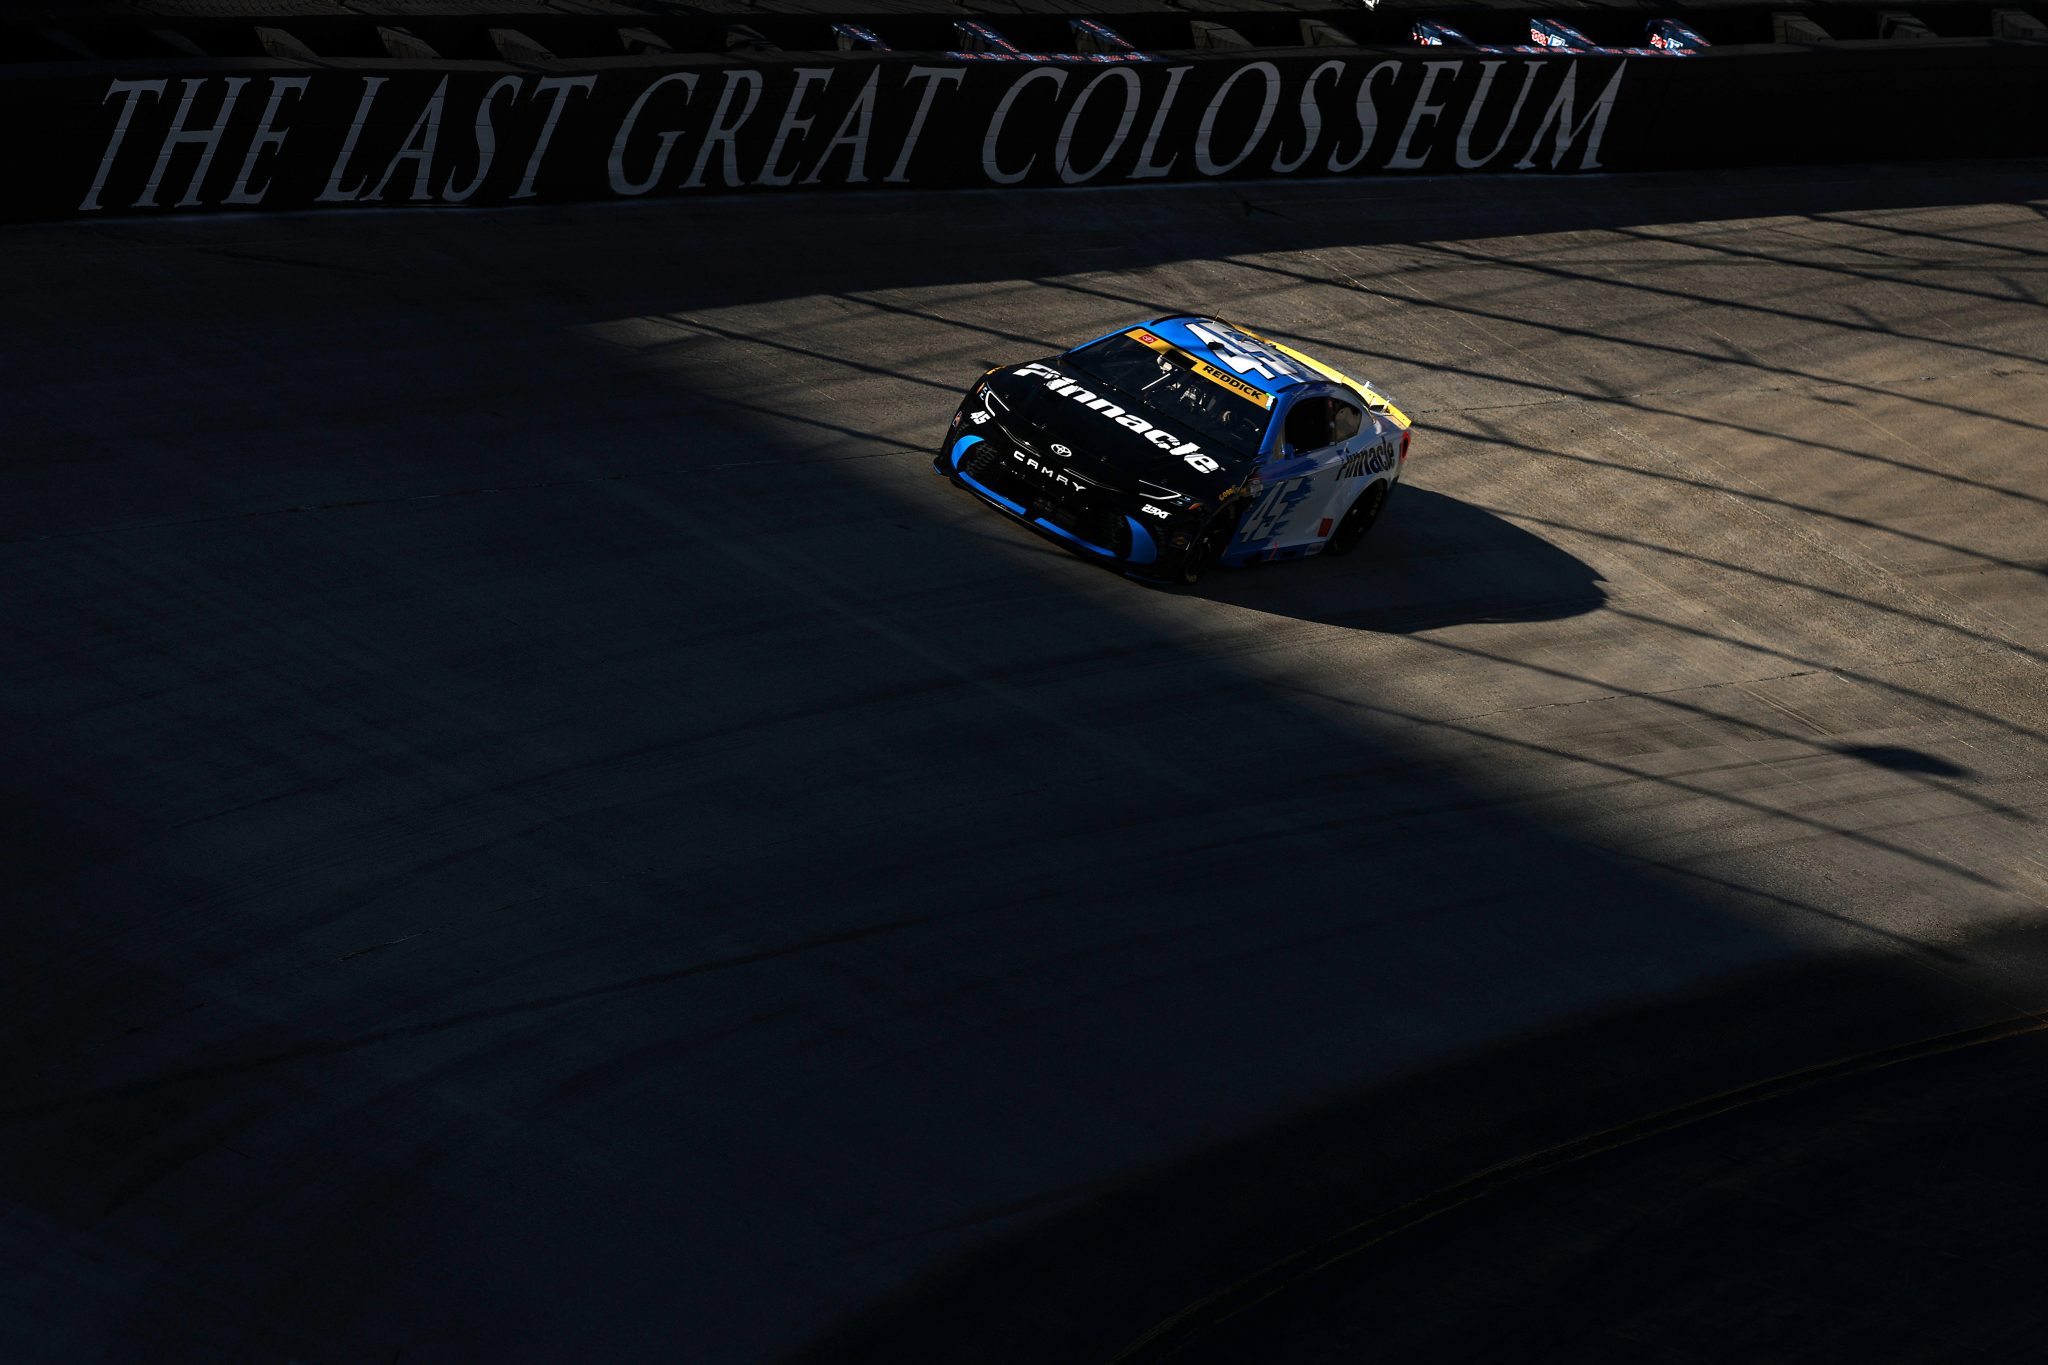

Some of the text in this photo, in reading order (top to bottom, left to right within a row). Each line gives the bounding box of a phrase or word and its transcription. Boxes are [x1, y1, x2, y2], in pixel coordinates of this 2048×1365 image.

[78, 57, 1629, 212] THE LAST GREAT COLOSSEUM
[1202, 364, 1261, 401] REDDICK
[970, 410, 991, 425] 45
[1012, 362, 1220, 475] Pinnacle
[1013, 450, 1087, 492] CAMRY
[1335, 436, 1396, 481] Pinnacle
[1240, 477, 1305, 543] 45
